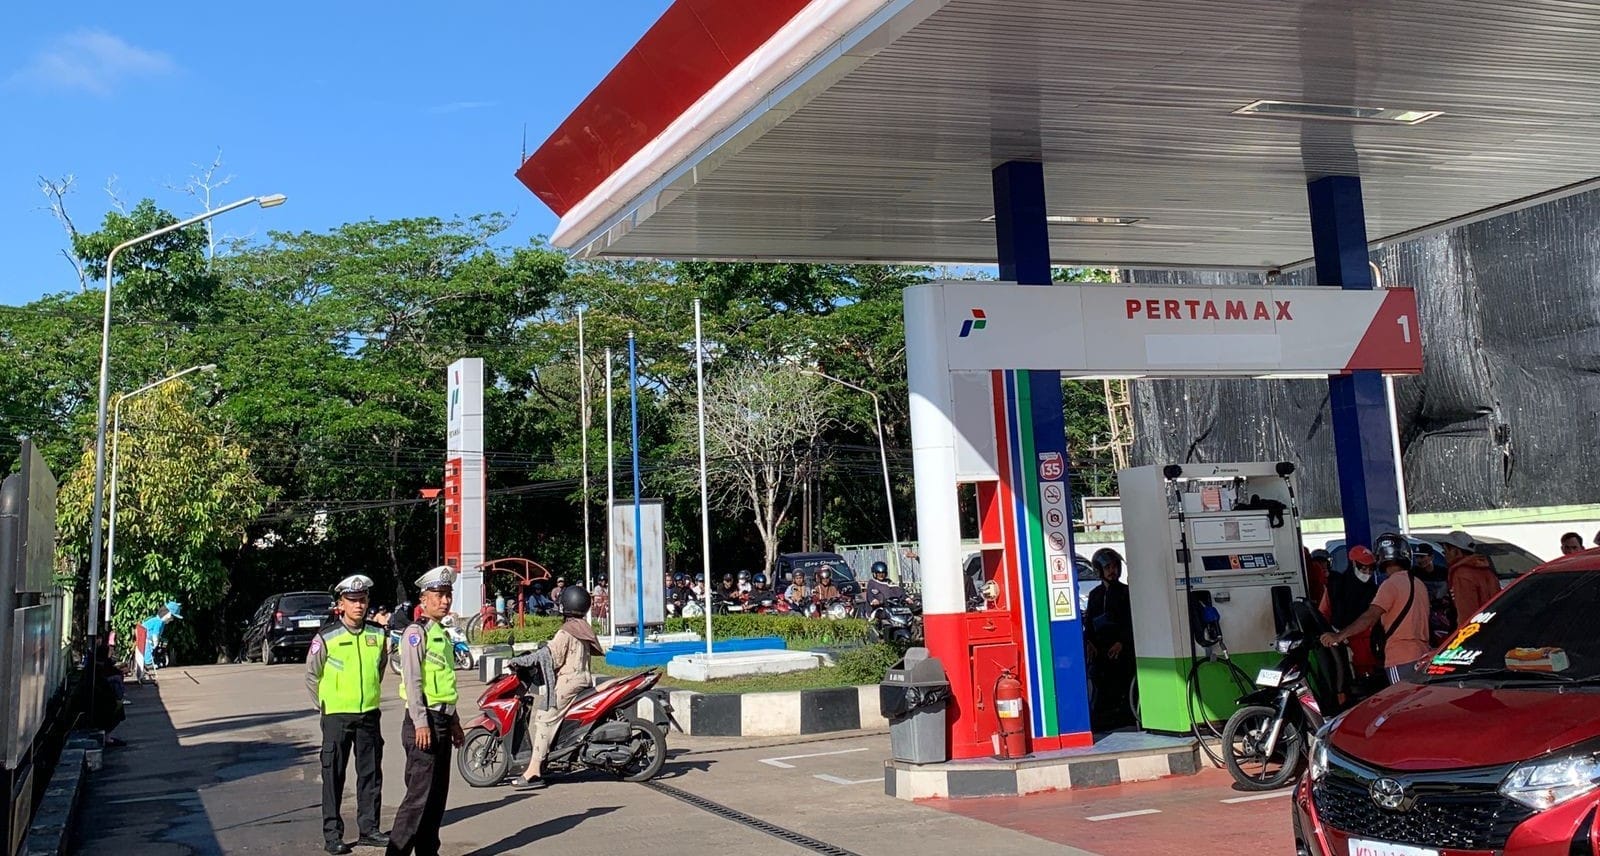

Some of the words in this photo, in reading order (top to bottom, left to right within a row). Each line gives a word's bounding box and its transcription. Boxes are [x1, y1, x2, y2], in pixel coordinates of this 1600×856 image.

[1125, 299, 1293, 321] PERTAMAX
[1397, 315, 1411, 343] 1
[1042, 462, 1061, 476] 135
